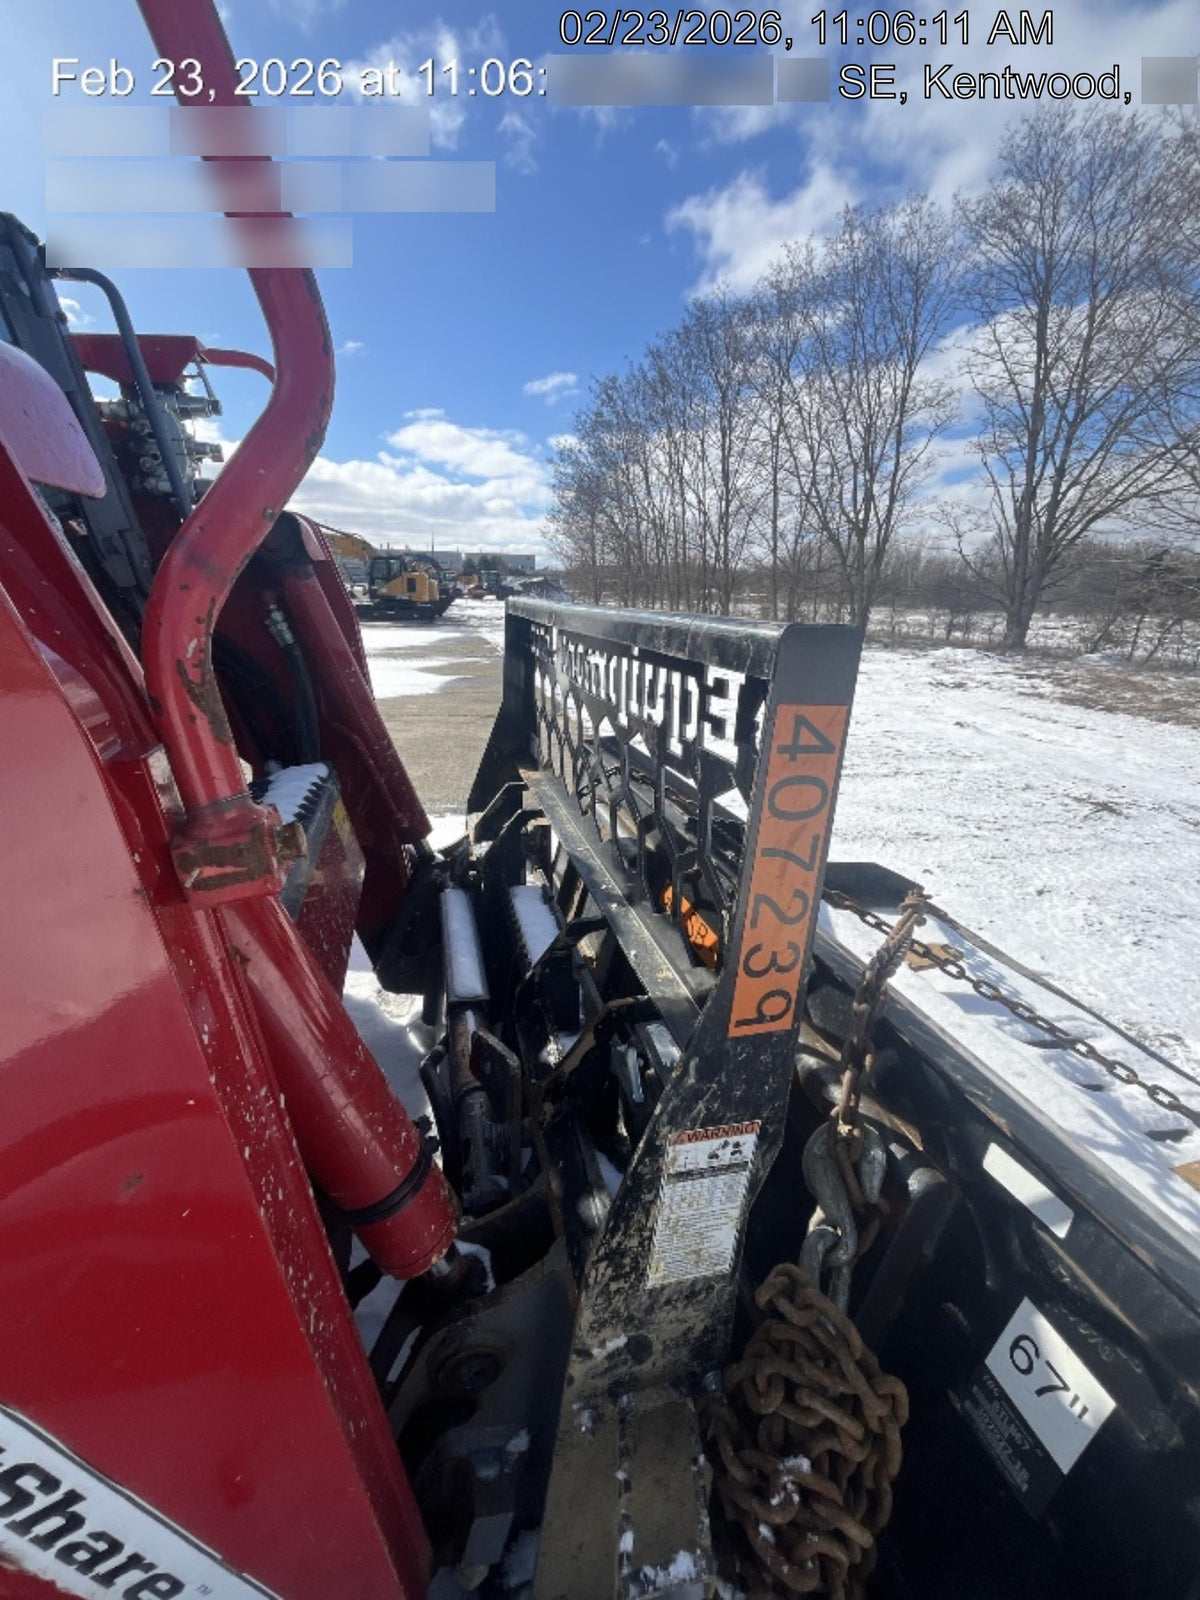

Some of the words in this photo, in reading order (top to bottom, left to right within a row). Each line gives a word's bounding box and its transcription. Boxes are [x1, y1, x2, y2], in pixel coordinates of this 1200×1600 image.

[735, 714, 836, 1028] 407239
[687, 1122, 755, 1142] WARNING
[0, 1448, 186, 1600] Share
